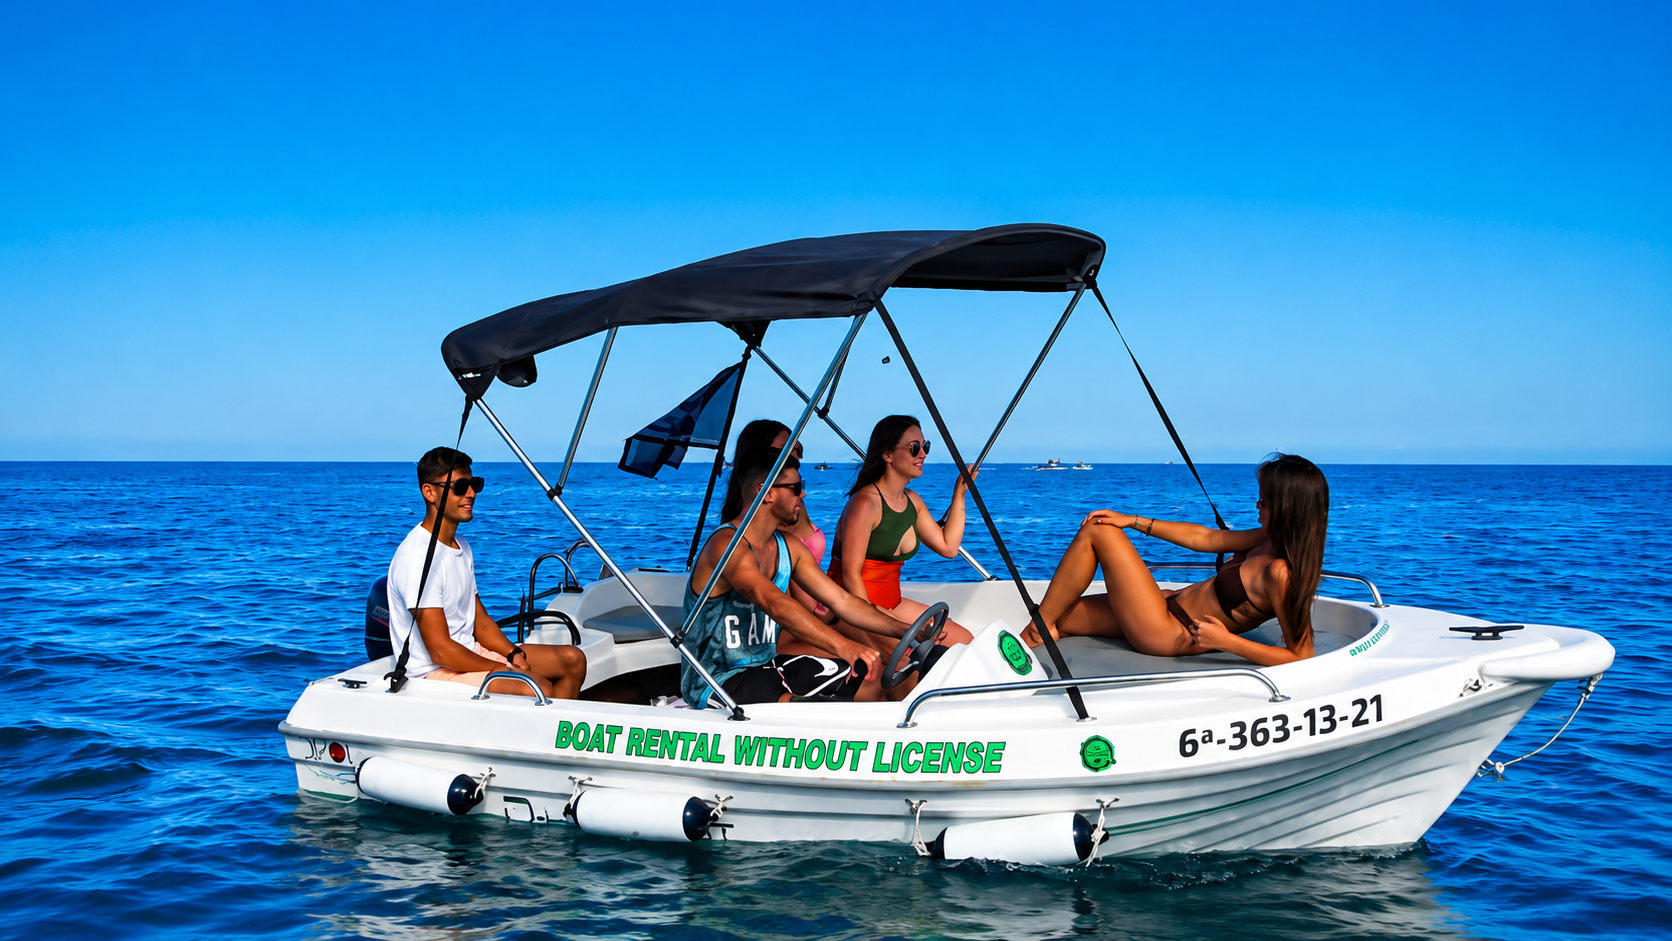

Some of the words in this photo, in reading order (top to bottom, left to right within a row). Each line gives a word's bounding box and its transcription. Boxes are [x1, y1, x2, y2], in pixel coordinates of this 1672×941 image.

[555, 720, 623, 754] BOAT
[626, 727, 726, 764] RENTAL
[733, 735, 869, 773] WITHOUT
[871, 741, 1006, 774] LICENSE
